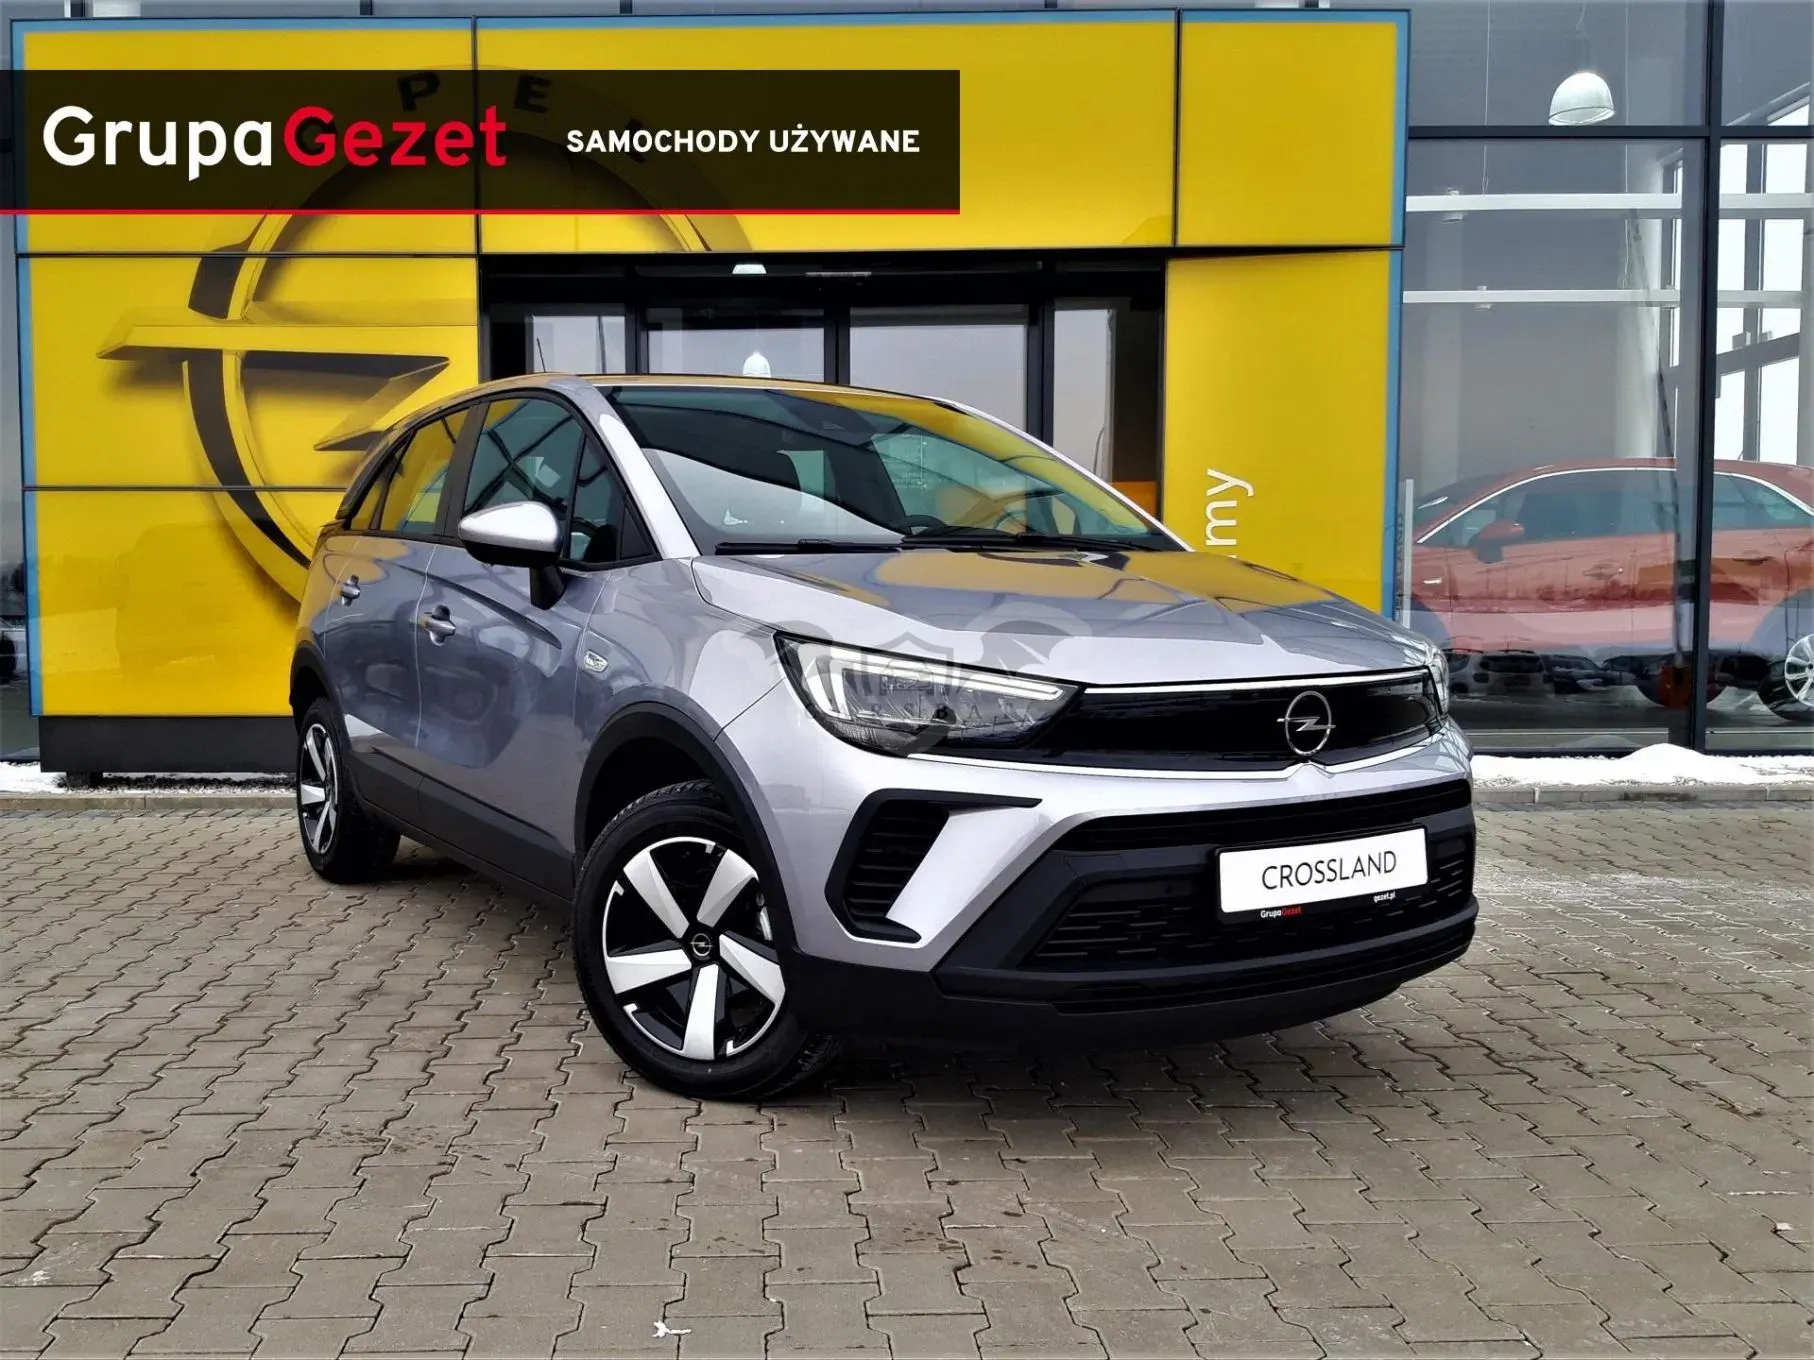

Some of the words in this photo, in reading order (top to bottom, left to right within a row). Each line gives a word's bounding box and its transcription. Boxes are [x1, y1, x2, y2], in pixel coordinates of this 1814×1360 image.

[1205, 468, 1254, 558] my
[1262, 850, 1397, 890] CROSSLAND
[1373, 891, 1396, 903] gezet.pl
